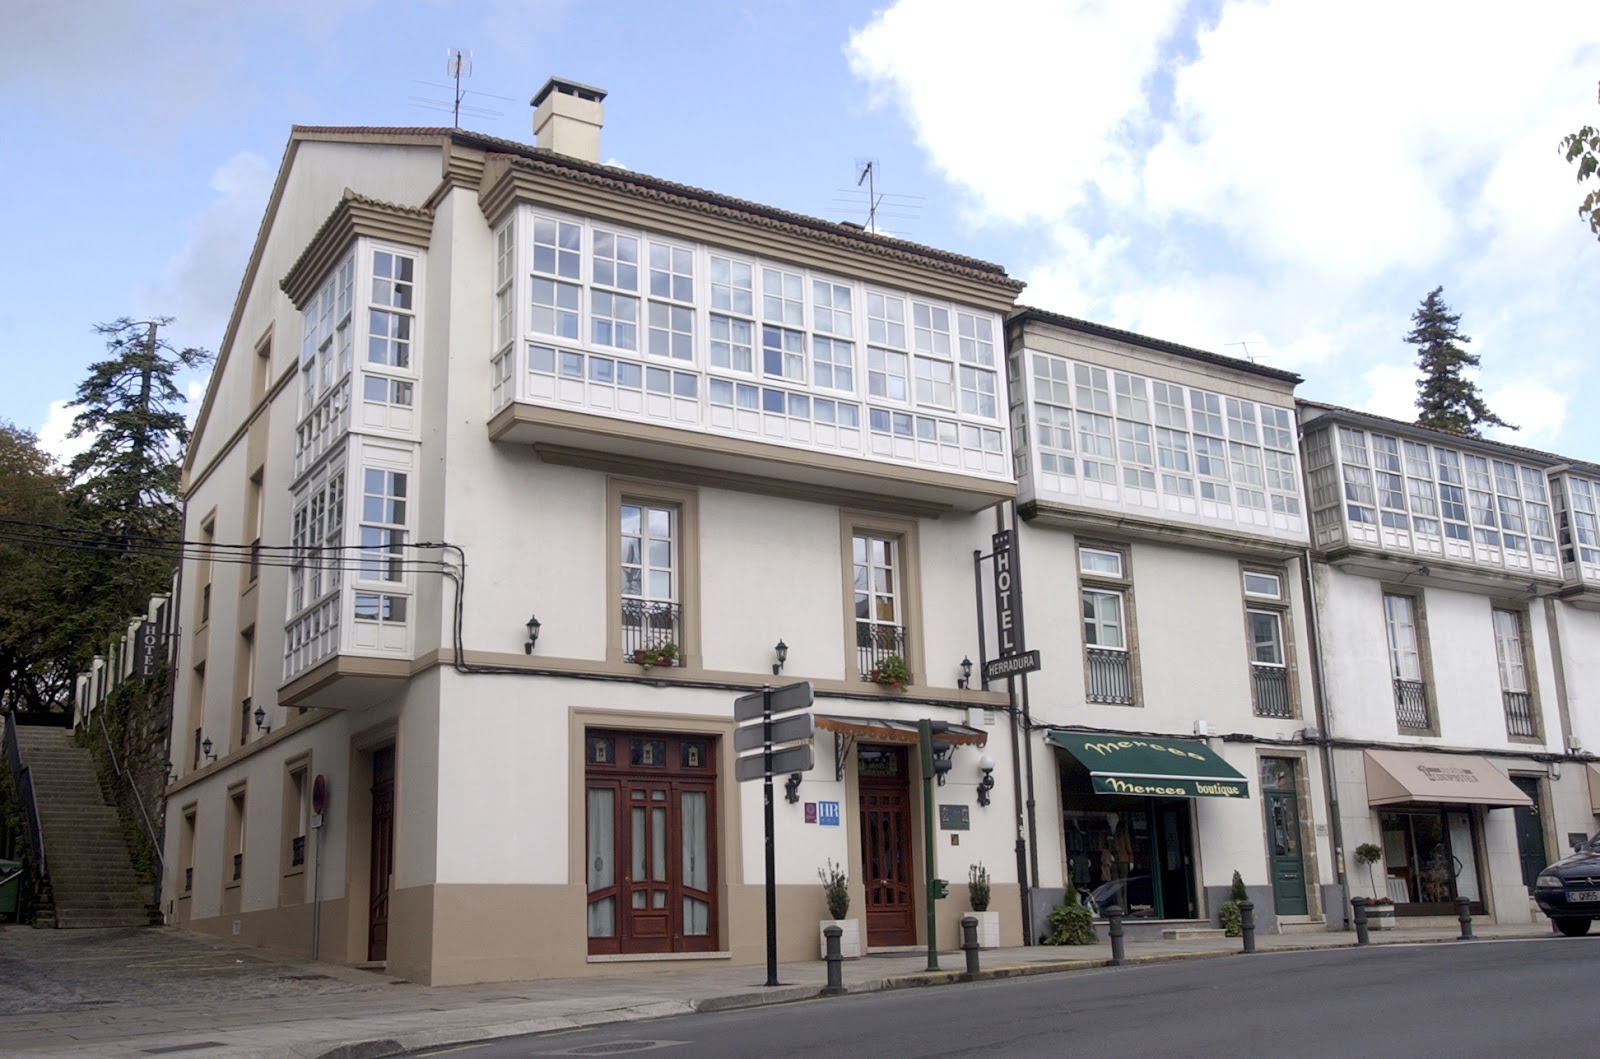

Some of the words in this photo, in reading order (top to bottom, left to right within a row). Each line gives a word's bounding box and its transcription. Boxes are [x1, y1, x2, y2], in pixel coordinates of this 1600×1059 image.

[998, 552, 1013, 649] HOTEL
[144, 625, 156, 676] HOTEL
[988, 655, 1034, 676] HERRADURA
[1105, 777, 1187, 795] Merces
[1195, 781, 1240, 797] boutique
